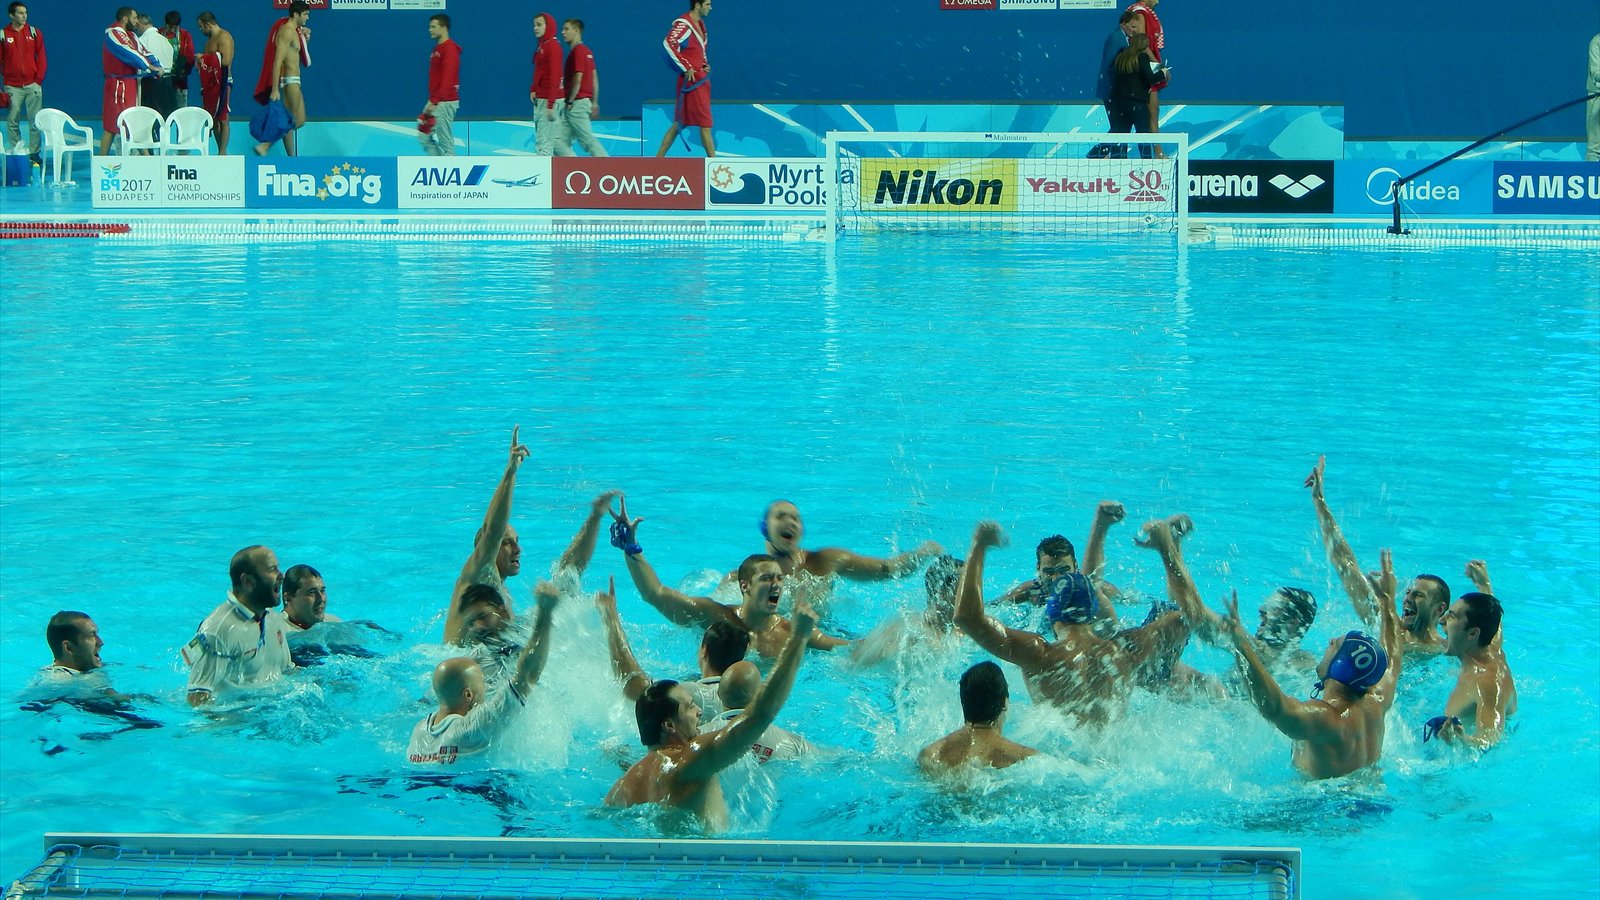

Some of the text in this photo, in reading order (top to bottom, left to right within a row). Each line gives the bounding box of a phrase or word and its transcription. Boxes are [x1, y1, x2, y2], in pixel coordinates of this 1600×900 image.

[167, 164, 197, 180] Fina
[411, 167, 461, 186] ANA
[768, 164, 855, 188] Myrta
[122, 179, 152, 191] 2017
[167, 184, 201, 192] WORLD
[599, 174, 693, 195] OMEGA
[874, 169, 1004, 206] Nikon
[1025, 177, 1121, 194] Yakult
[1188, 174, 1259, 197] arena
[100, 193, 155, 201] BUDAPEST
[167, 193, 241, 201] CHAMPIONSHIPS
[410, 191, 489, 200] Inspiration of JAPAN
[1350, 644, 1373, 669] 10
